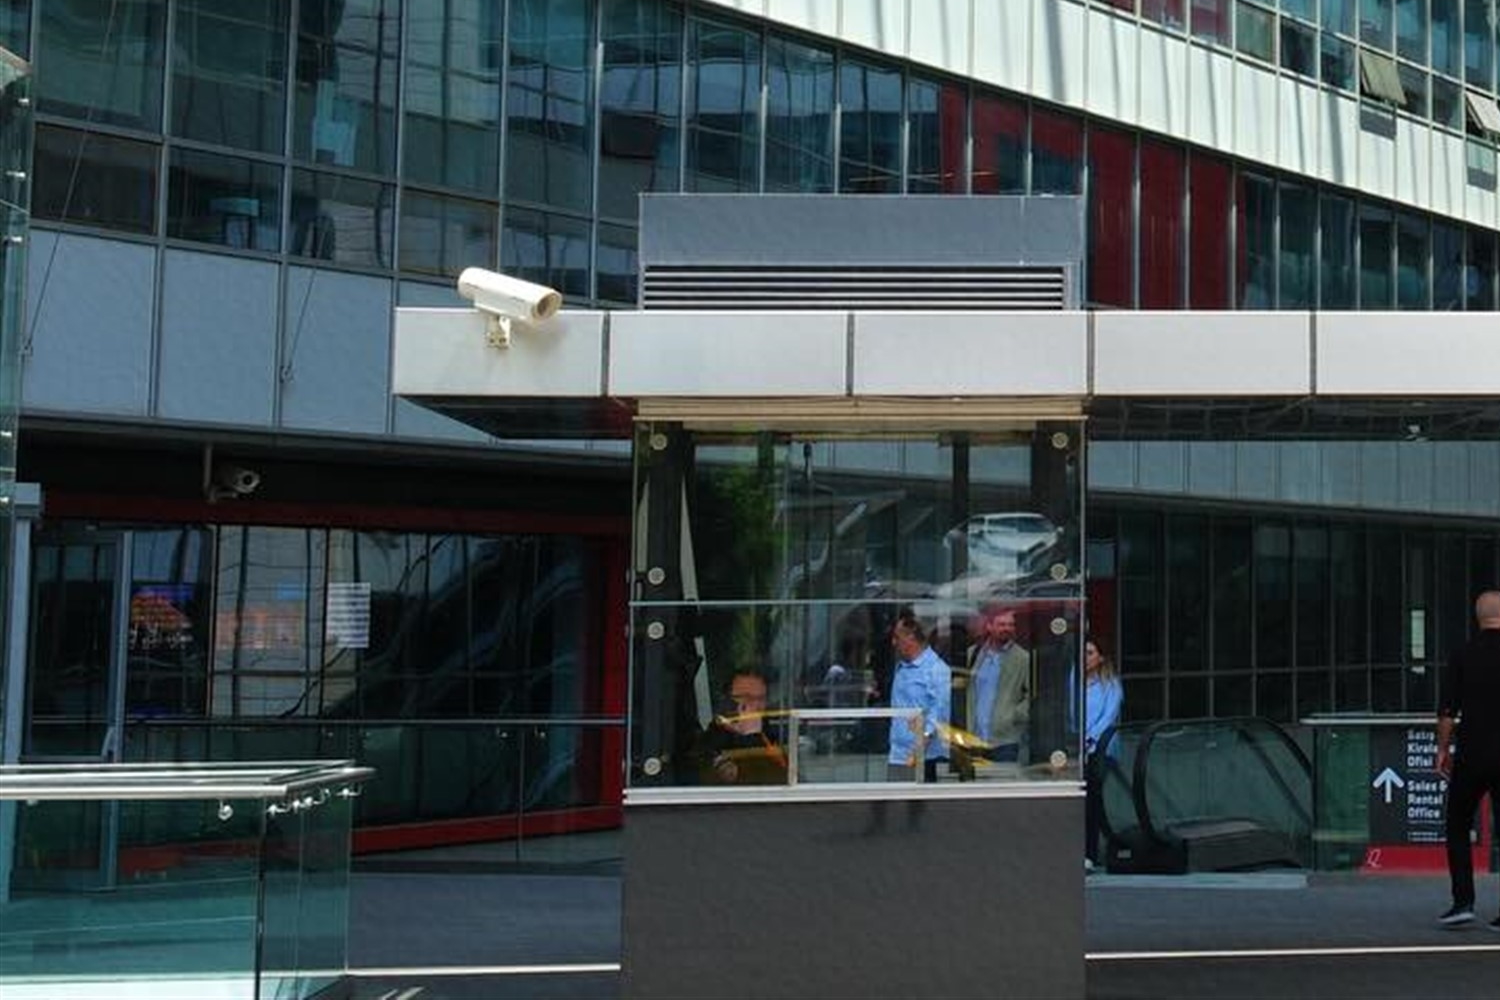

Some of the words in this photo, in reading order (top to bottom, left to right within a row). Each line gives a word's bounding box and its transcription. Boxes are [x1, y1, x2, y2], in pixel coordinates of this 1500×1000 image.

[1407, 780, 1437, 792] Sales
[1407, 793, 1443, 805] Rental
[1407, 806, 1440, 818] Office
